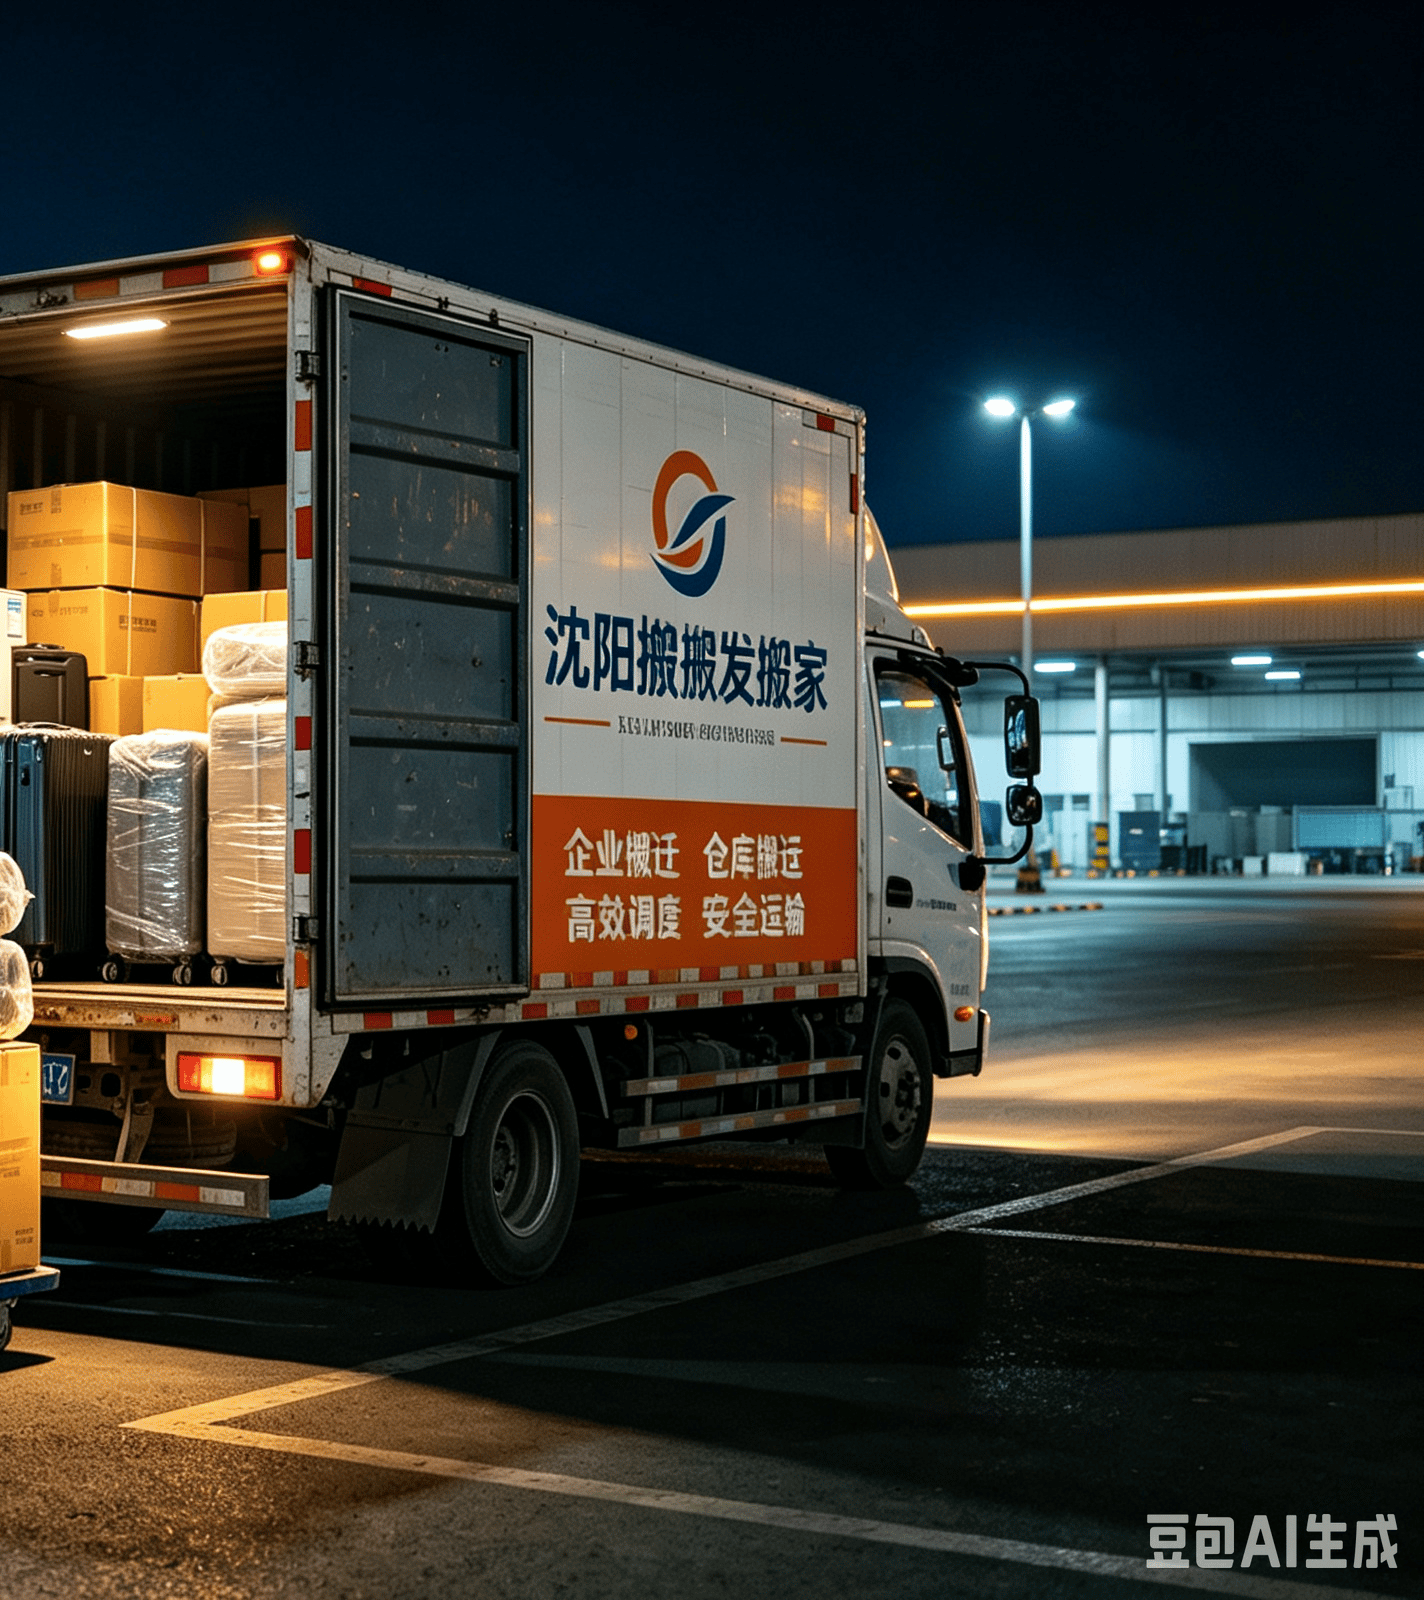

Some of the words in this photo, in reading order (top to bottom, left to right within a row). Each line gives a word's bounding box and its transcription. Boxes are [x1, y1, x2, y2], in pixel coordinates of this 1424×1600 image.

[565, 893, 682, 943] 高效调度
[702, 891, 805, 938] 安全运输
